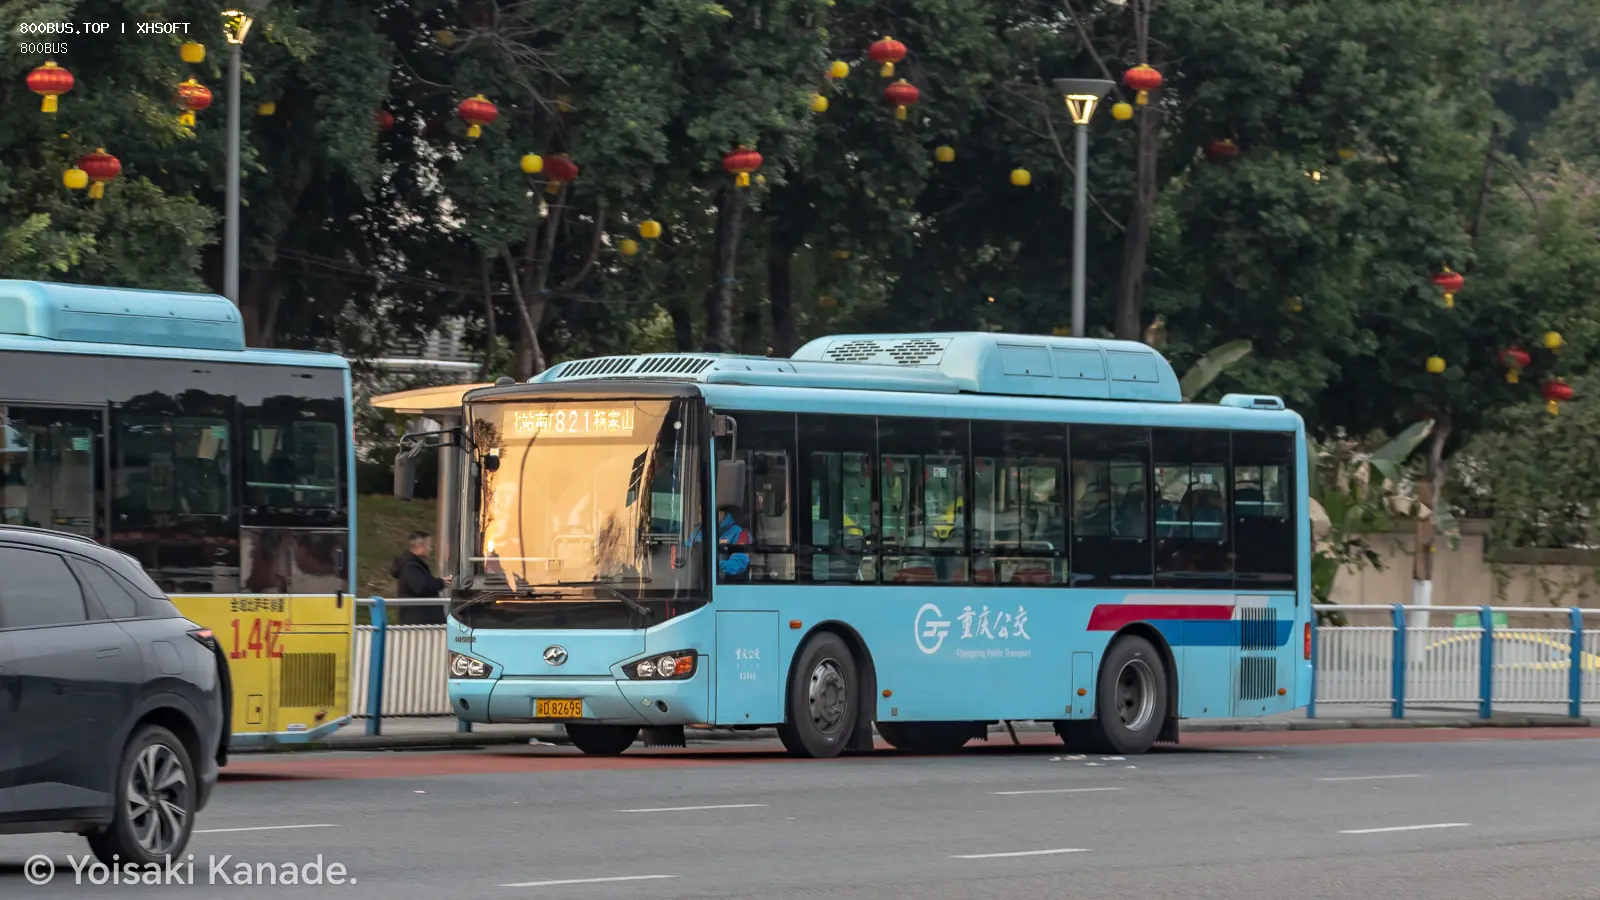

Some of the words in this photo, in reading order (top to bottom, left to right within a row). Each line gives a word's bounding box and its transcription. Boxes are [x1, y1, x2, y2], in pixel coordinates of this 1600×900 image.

[555, 410, 589, 433] 821
[593, 409, 634, 433] 杨家山
[957, 605, 1031, 641] 重庆公交
